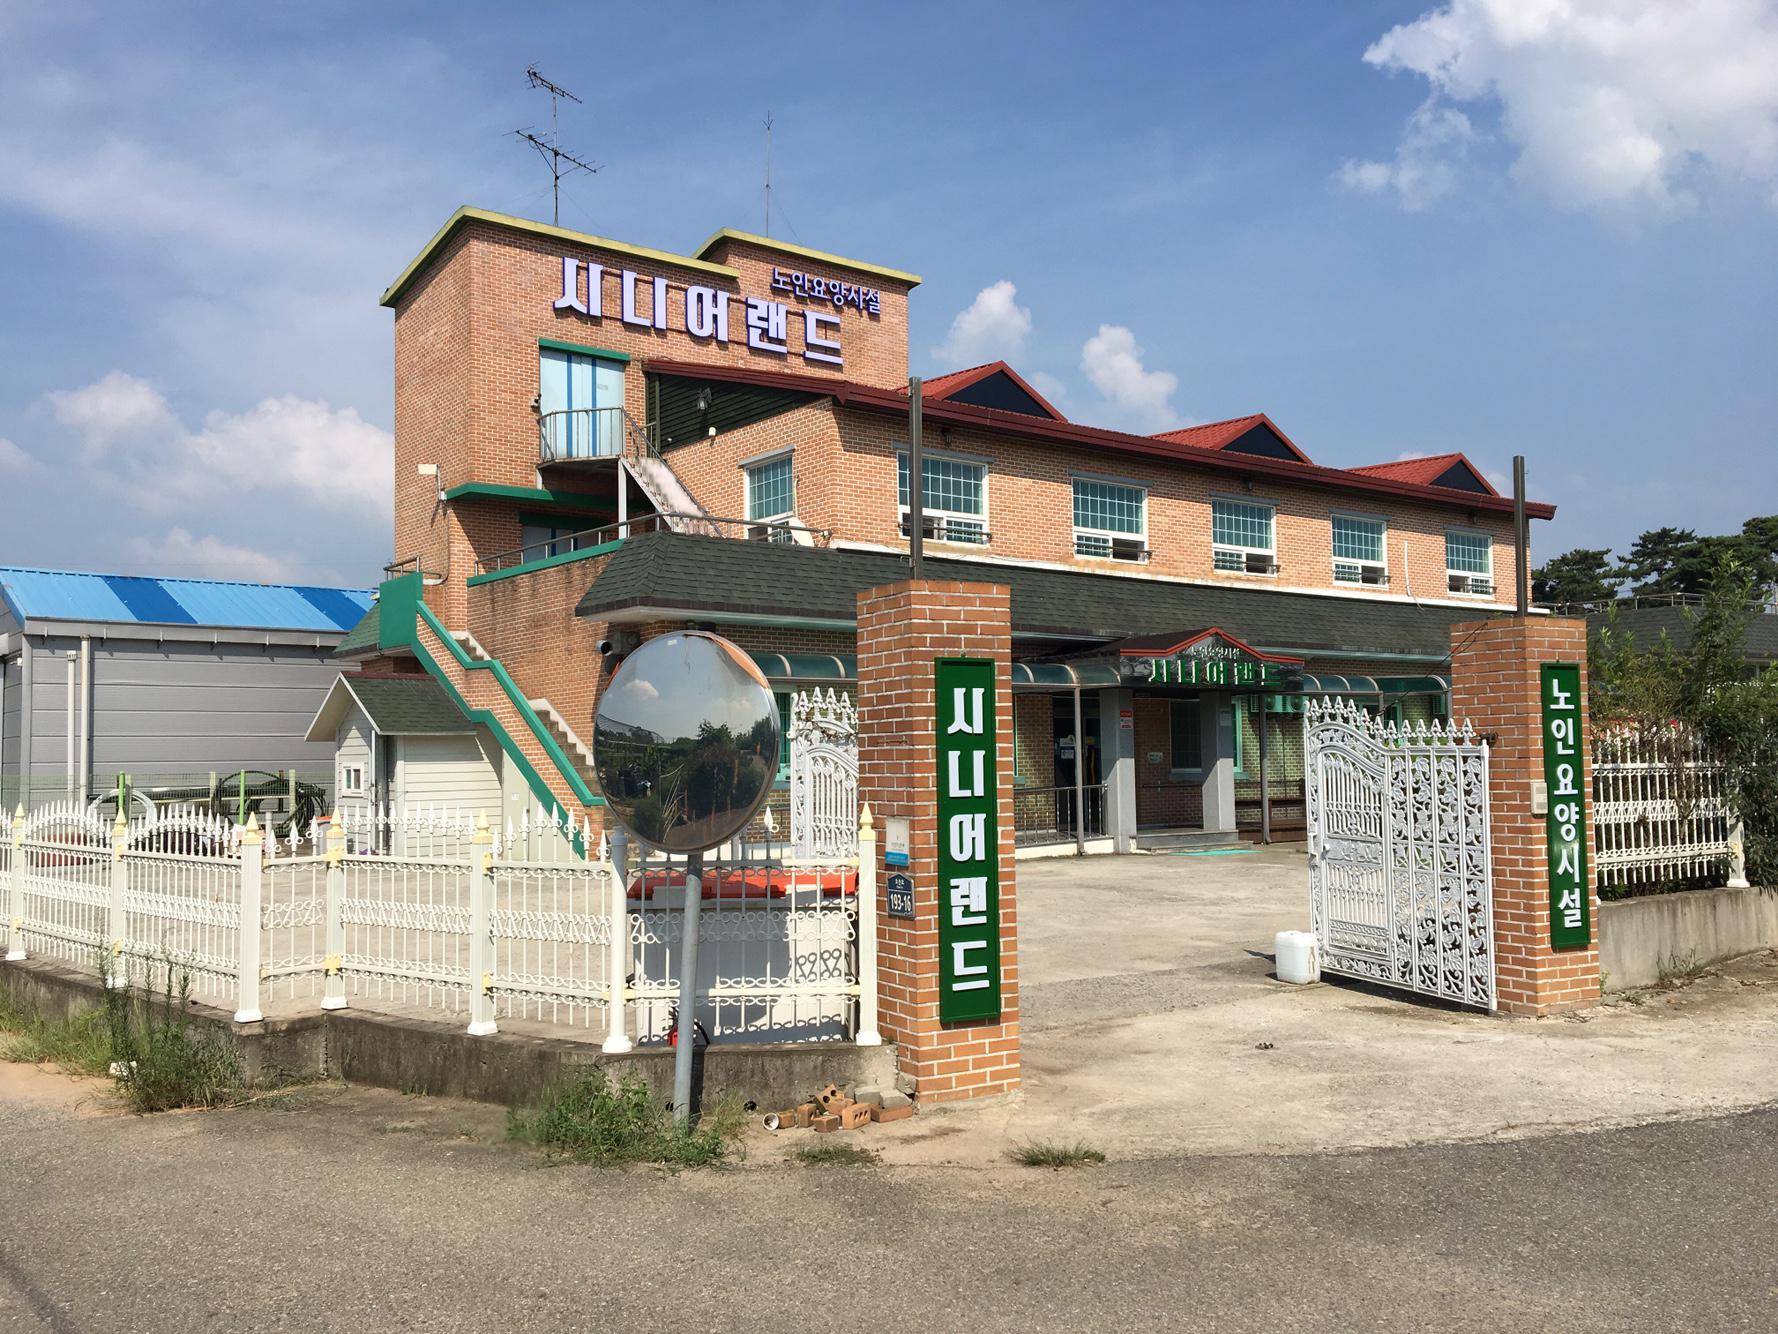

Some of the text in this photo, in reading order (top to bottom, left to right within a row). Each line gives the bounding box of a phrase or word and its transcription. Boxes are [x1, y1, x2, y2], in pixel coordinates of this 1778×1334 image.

[553, 256, 844, 365] 시니어랜드
[771, 267, 881, 315] 노인요양시설
[1148, 659, 1281, 687] 시니어랜드
[947, 687, 990, 992] 시니어랜드
[1550, 678, 1583, 929] 노인요양시설
[890, 893, 912, 912] 193-16
